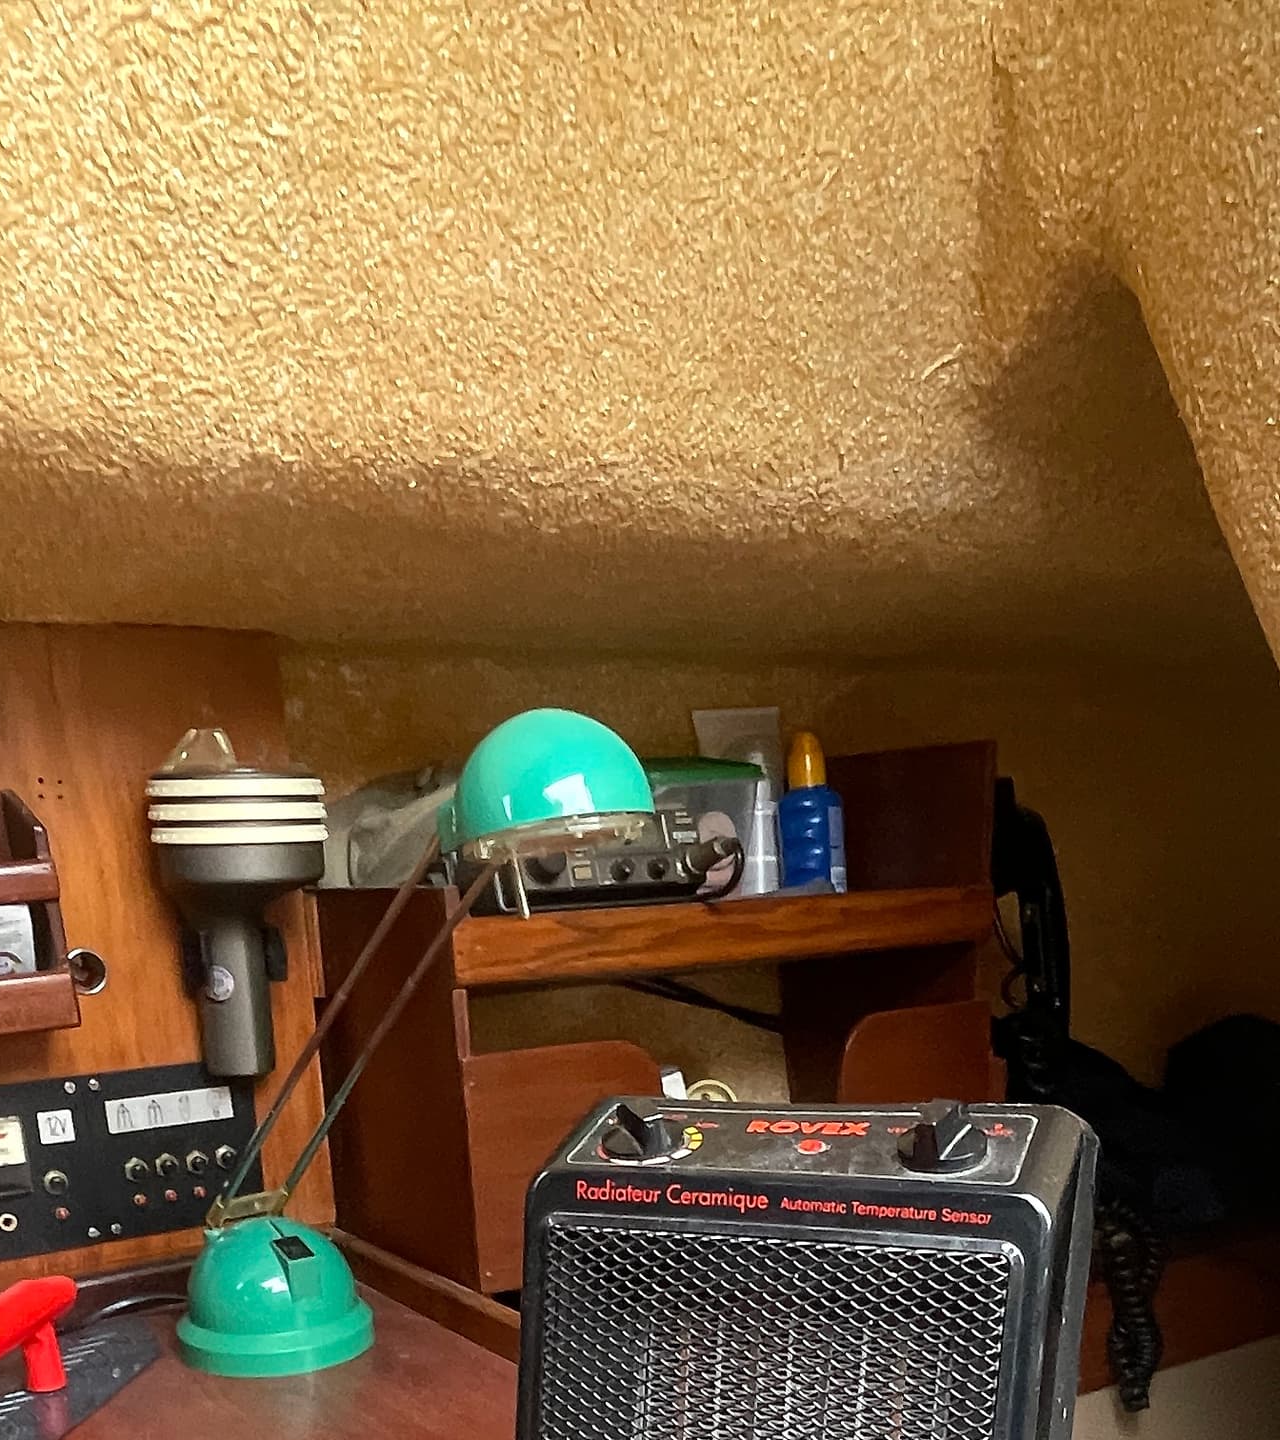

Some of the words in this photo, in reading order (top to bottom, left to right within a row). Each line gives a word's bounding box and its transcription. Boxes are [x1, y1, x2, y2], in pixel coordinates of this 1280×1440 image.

[746, 1119, 871, 1137] ROVEX
[576, 1179, 661, 1204] Radiateur
[666, 1184, 769, 1214] Ceramique
[780, 1197, 847, 1215] Automatic
[852, 1202, 937, 1222] Temperature
[941, 1208, 992, 1226] Sensor
